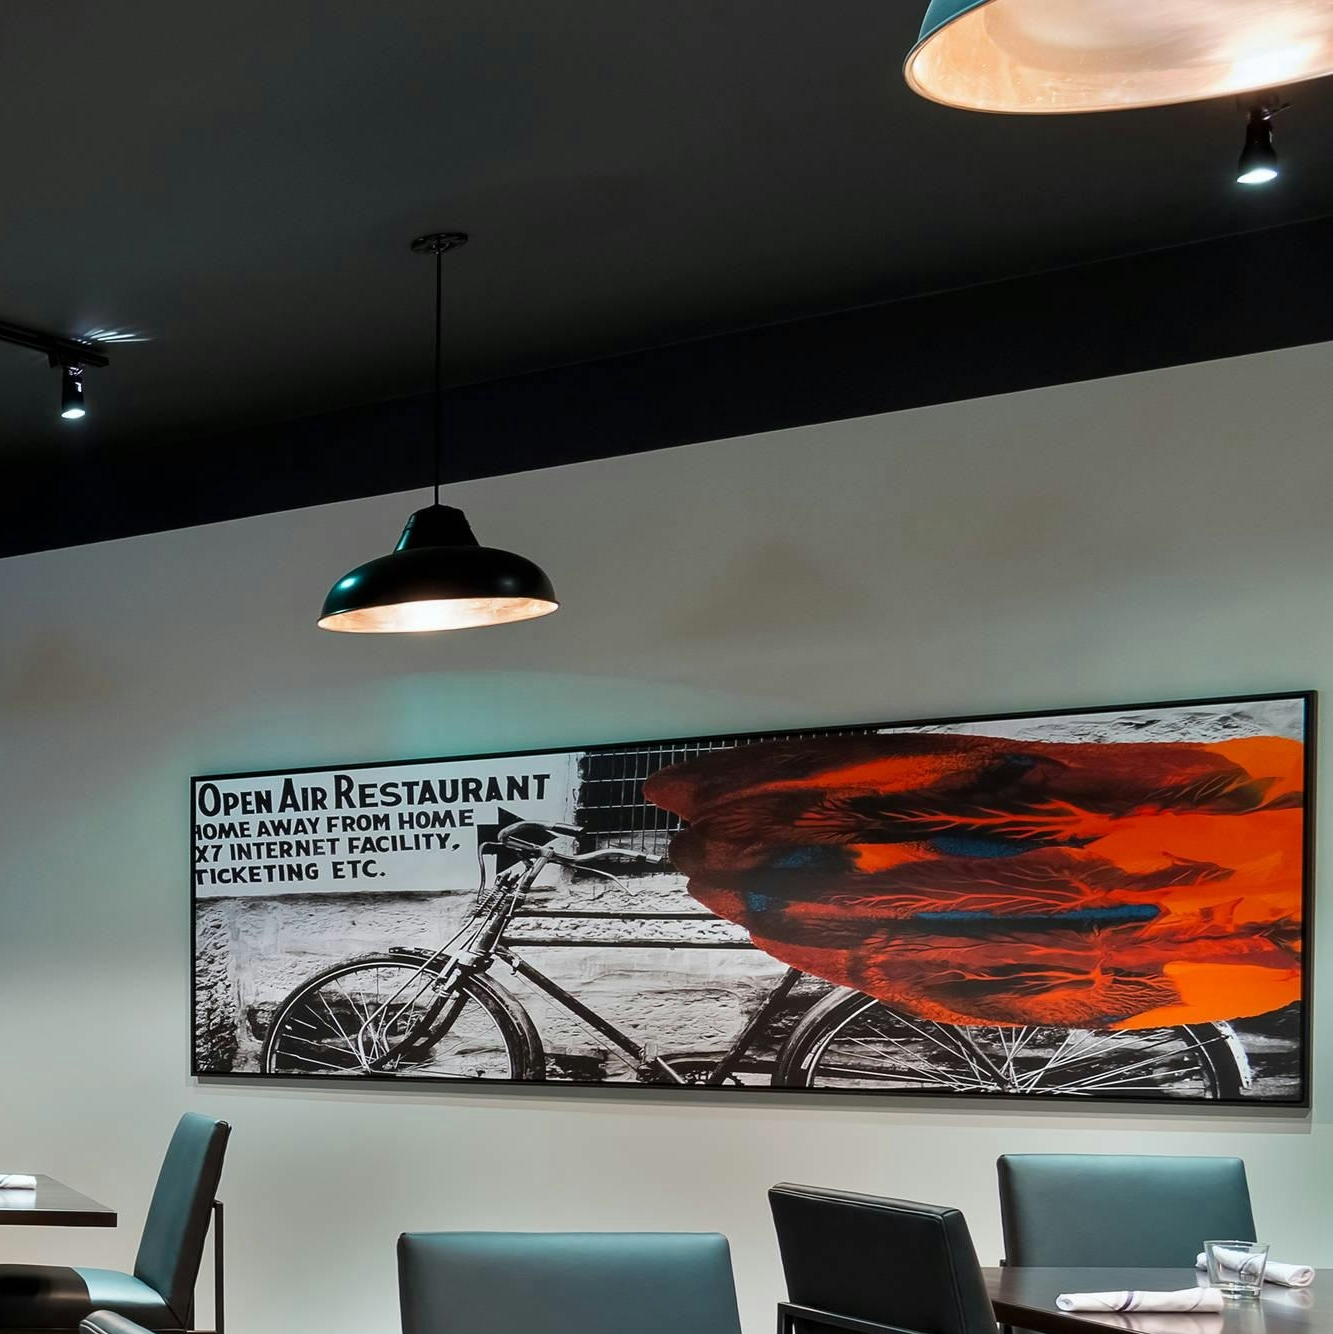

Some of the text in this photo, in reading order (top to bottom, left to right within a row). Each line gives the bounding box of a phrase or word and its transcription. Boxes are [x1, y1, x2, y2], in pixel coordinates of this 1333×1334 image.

[198, 773, 551, 817] OPEN AIR RESTAURANT
[256, 816, 320, 838] AWAY
[326, 812, 391, 834] FROM
[397, 808, 475, 831] HOME
[229, 837, 341, 862] INTERNET
[347, 832, 461, 855] FACILITY,
[196, 859, 386, 886] TICKETING ETC.
